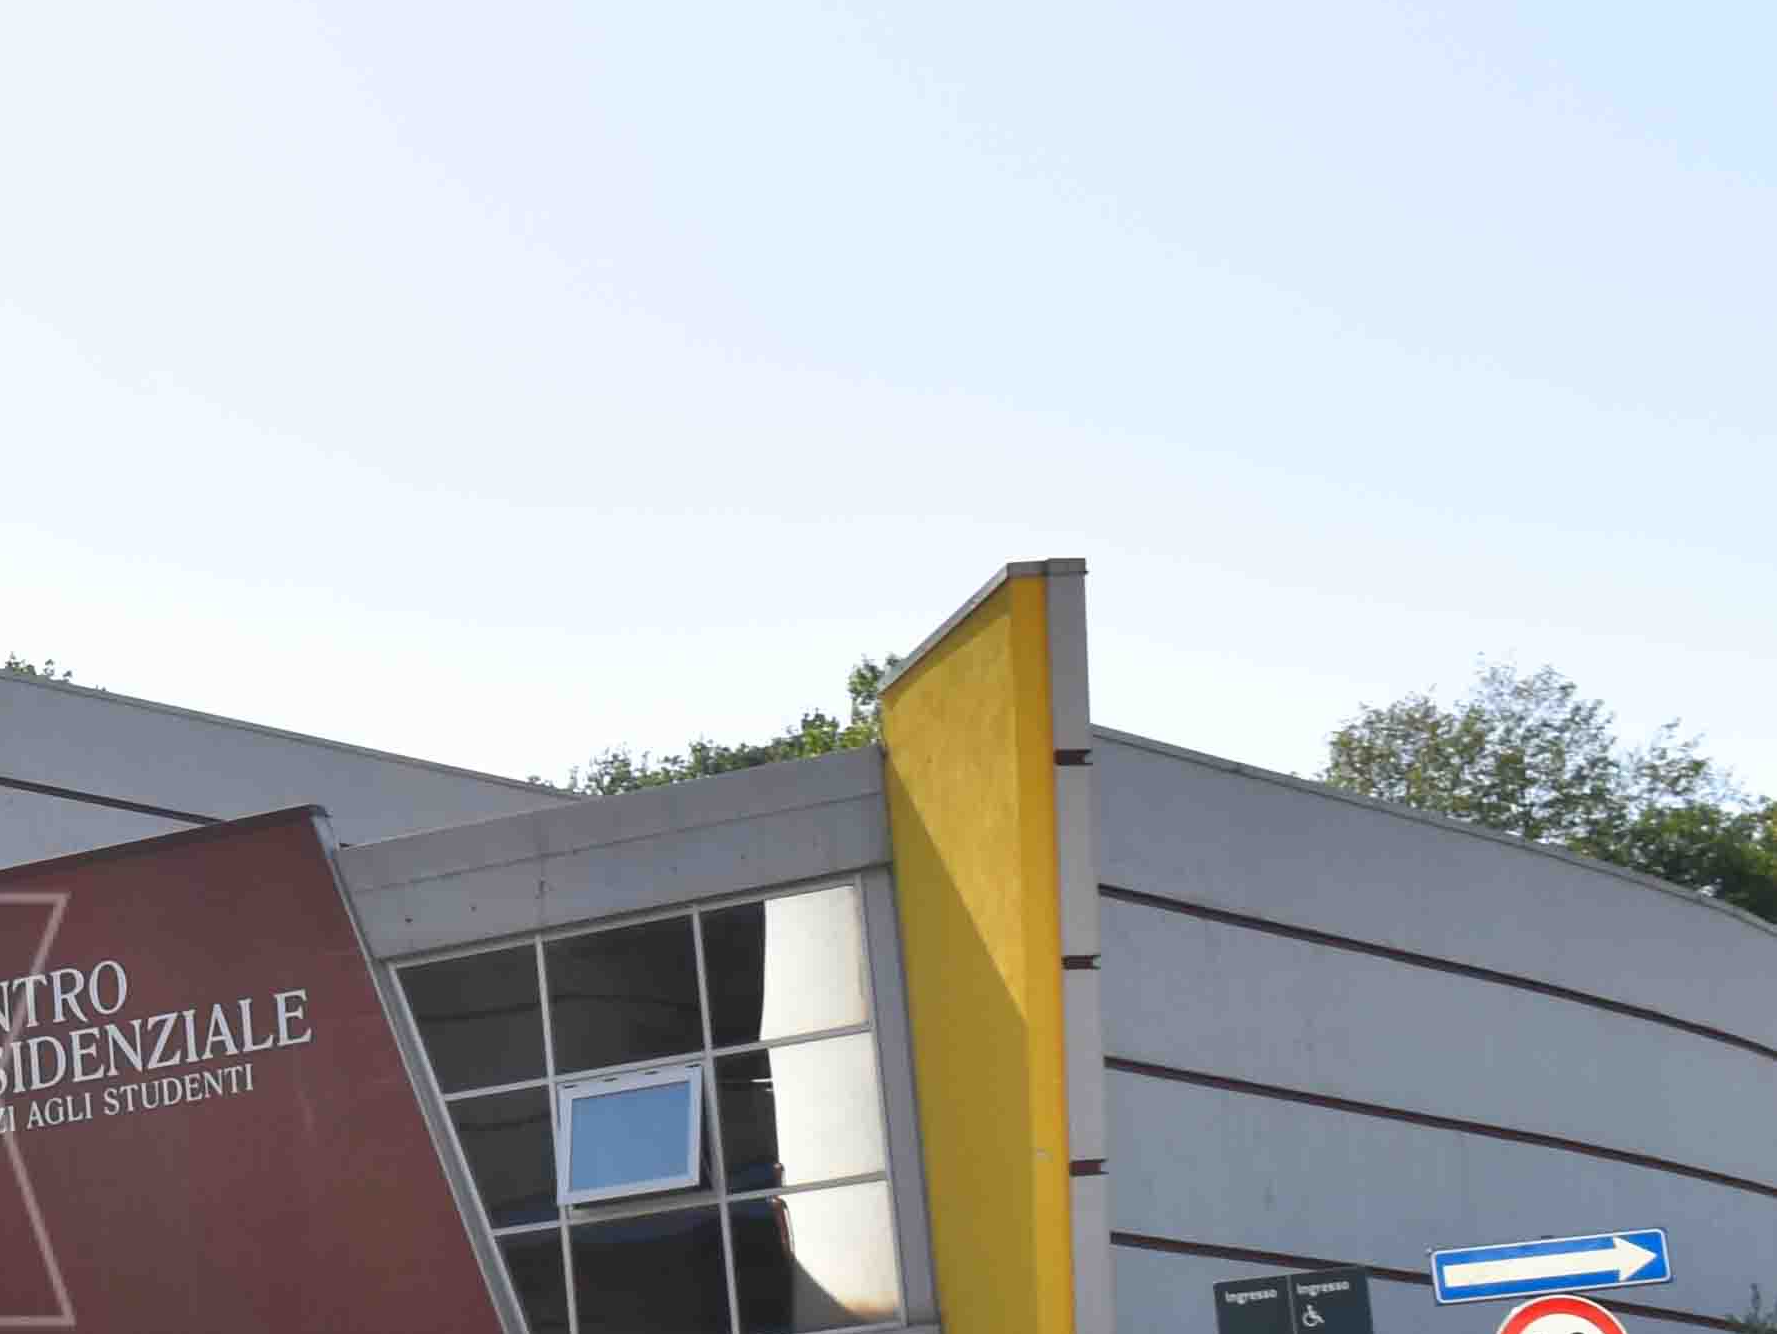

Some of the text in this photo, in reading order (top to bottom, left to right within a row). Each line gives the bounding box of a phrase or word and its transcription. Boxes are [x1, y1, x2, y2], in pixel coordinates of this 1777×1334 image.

[26, 1091, 93, 1130] AGLI
[103, 1063, 254, 1116] STUDENTI
[1225, 1289, 1278, 1305] Ingresso
[1296, 1281, 1350, 1297] Ingresso
